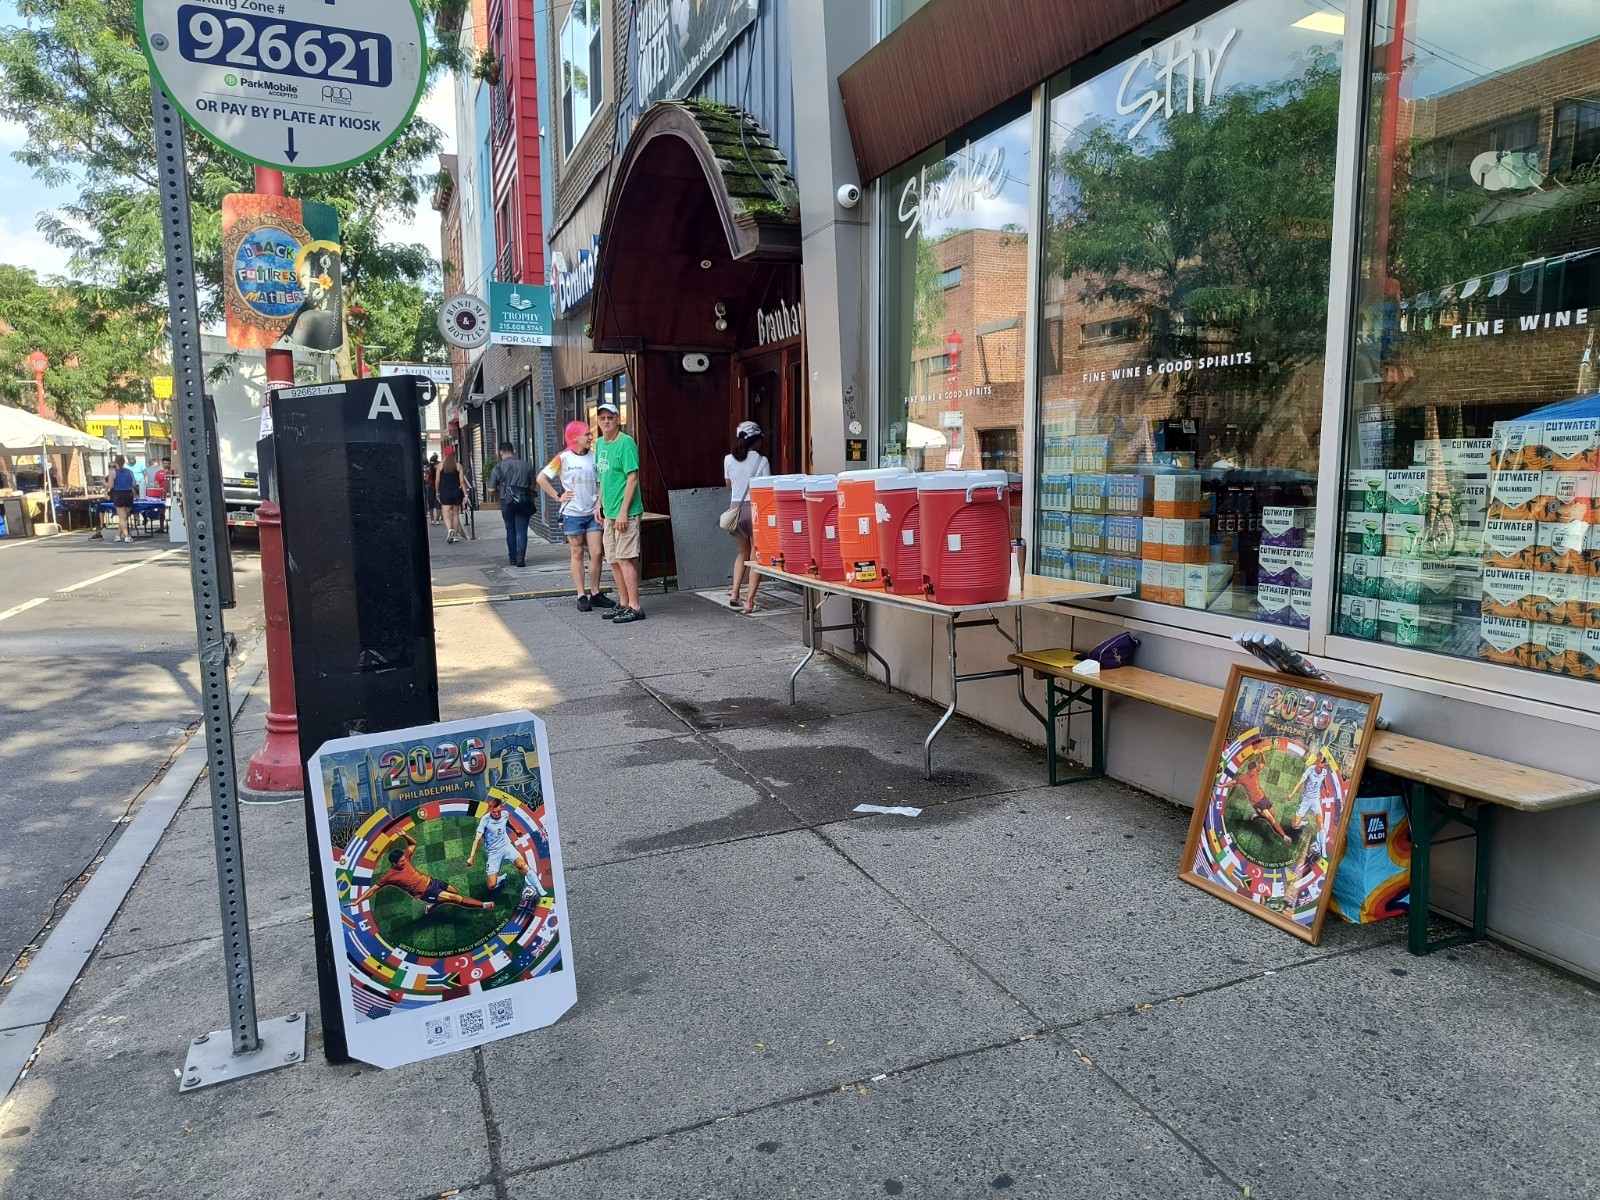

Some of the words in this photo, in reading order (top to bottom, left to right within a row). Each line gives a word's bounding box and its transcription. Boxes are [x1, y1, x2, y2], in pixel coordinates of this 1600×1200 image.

[241, 0, 275, 14] Zone
[277, 4, 286, 15] #
[188, 12, 380, 83] 926621
[240, 77, 298, 94] ParkMobile
[1116, 26, 1238, 140] Stir
[268, 91, 299, 99] ACCEPTED
[196, 99, 218, 113] OR
[221, 102, 248, 116] PAY
[252, 105, 270, 119] BY
[273, 108, 316, 125] PLATE
[318, 114, 336, 127] AT
[339, 117, 381, 132] KIOSK
[899, 138, 1008, 239] Shake
[462, 316, 470, 326] &
[502, 311, 540, 322] TROPHY
[1451, 319, 1504, 339] FINE
[1519, 308, 1589, 332] WINE
[447, 325, 486, 342] BOTTLES
[501, 335, 519, 344] FOR
[520, 336, 543, 345] SALE
[1082, 371, 1106, 384] FINE
[1112, 366, 1141, 380] WINE
[1146, 364, 1153, 376] &
[1158, 360, 1192, 374] GOOD
[1198, 351, 1253, 370] SPIRITS
[290, 388, 334, 398] 926621-A
[945, 390, 962, 399] GOOD
[965, 386, 992, 397] SPIRITS
[367, 382, 403, 421] A
[1545, 420, 1597, 431] CUTWATER
[1451, 441, 1491, 449] CUTWATER
[1388, 471, 1426, 480] CUTWATER
[1493, 472, 1540, 482] CUTWATER
[1263, 508, 1293, 517] CUTWATER
[1487, 520, 1533, 532] CUTWATER
[1260, 546, 1292, 557] CUTWATER
[1292, 549, 1314, 559] CUTWA
[1422, 561, 1456, 571] CUTWATER
[1485, 569, 1531, 581] CUTWATER
[1258, 584, 1289, 596] CUTWATER
[1291, 588, 1312, 598] CUTWA
[1483, 615, 1528, 629] CUTWATER
[1264, 686, 1334, 731] 2026
[1308, 732, 1316, 741] PA
[380, 737, 487, 791] 2026
[399, 783, 463, 802] PHILADELPHIA,
[464, 780, 475, 789] PA
[1368, 832, 1385, 841] ALDI
[398, 942, 416, 953] UNITED
[415, 949, 439, 957] THROUGH
[438, 949, 454, 957] SPORT
[458, 943, 475, 954] PHILLY
[474, 935, 489, 948] HOSTS
[488, 930, 497, 940] THE
[496, 917, 510, 932] WORLD
